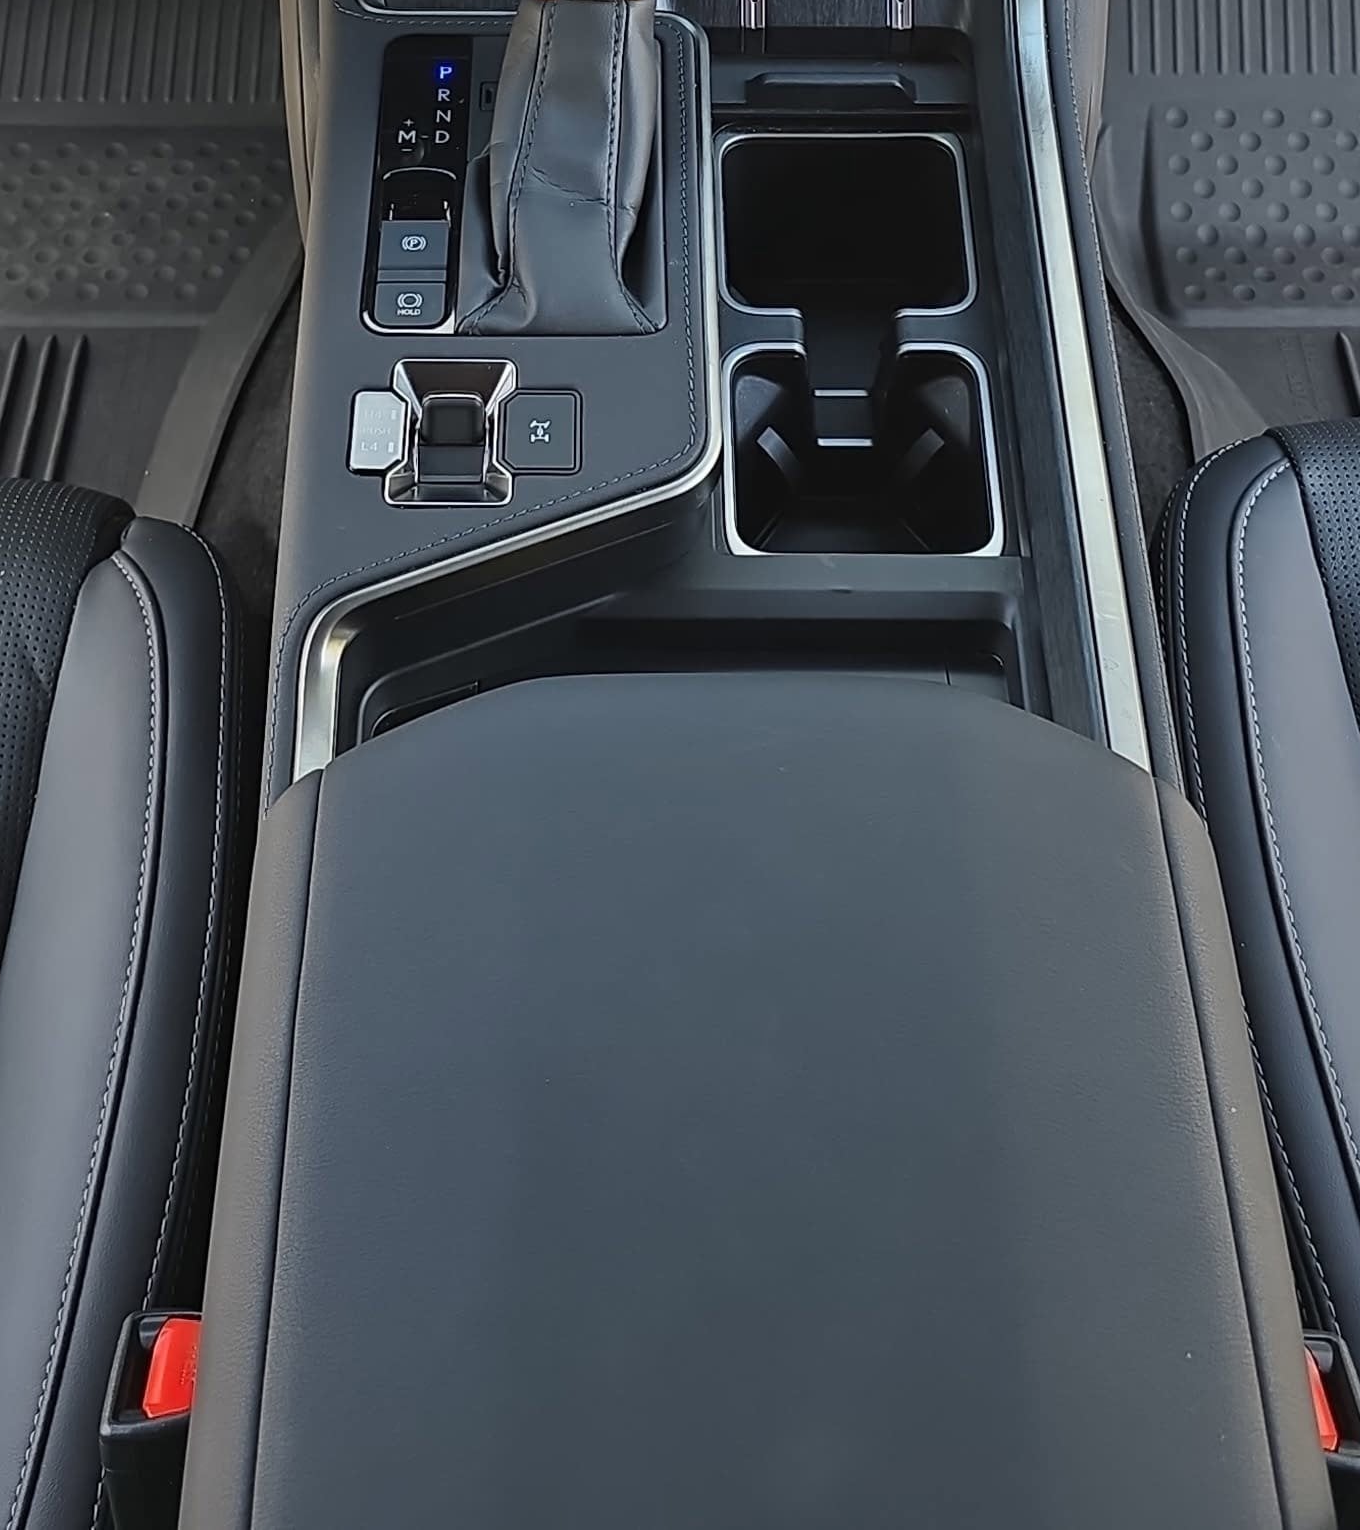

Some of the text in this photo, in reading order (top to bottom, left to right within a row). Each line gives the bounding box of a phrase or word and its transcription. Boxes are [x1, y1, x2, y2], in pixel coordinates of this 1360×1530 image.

[439, 66, 453, 80] P
[437, 88, 451, 102] R
[436, 109, 452, 123] N
[435, 130, 450, 144] D
[360, 441, 379, 452] L4
